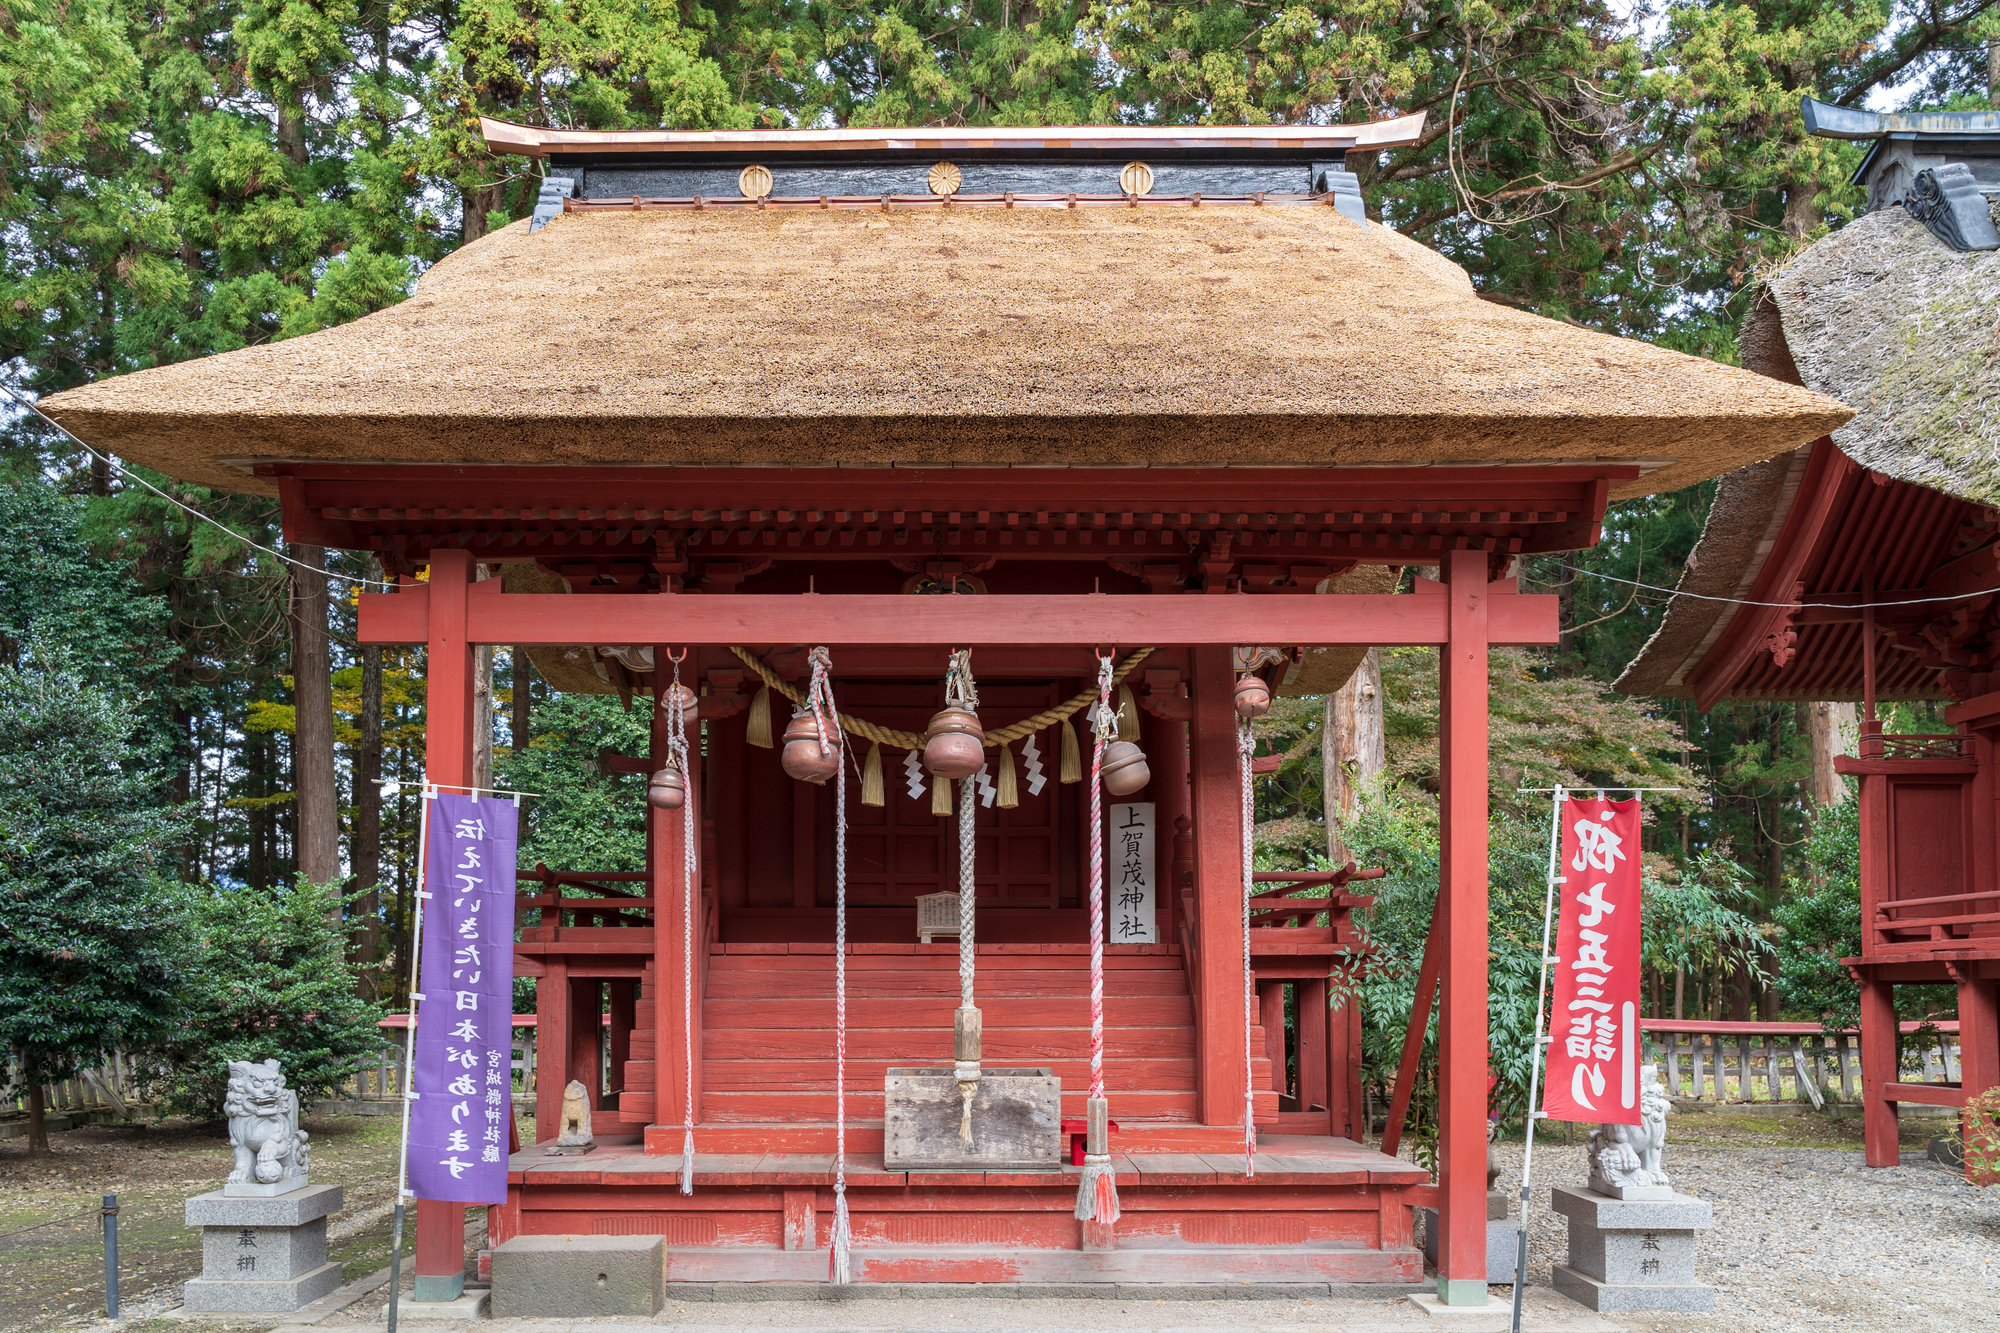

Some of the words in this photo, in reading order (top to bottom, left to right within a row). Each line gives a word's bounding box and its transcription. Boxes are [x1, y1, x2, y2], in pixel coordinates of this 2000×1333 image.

[1117, 806, 1147, 939] 上賀茂神社
[236, 1229, 259, 1272] 奉納
[1639, 1232, 1661, 1276] 奉納
